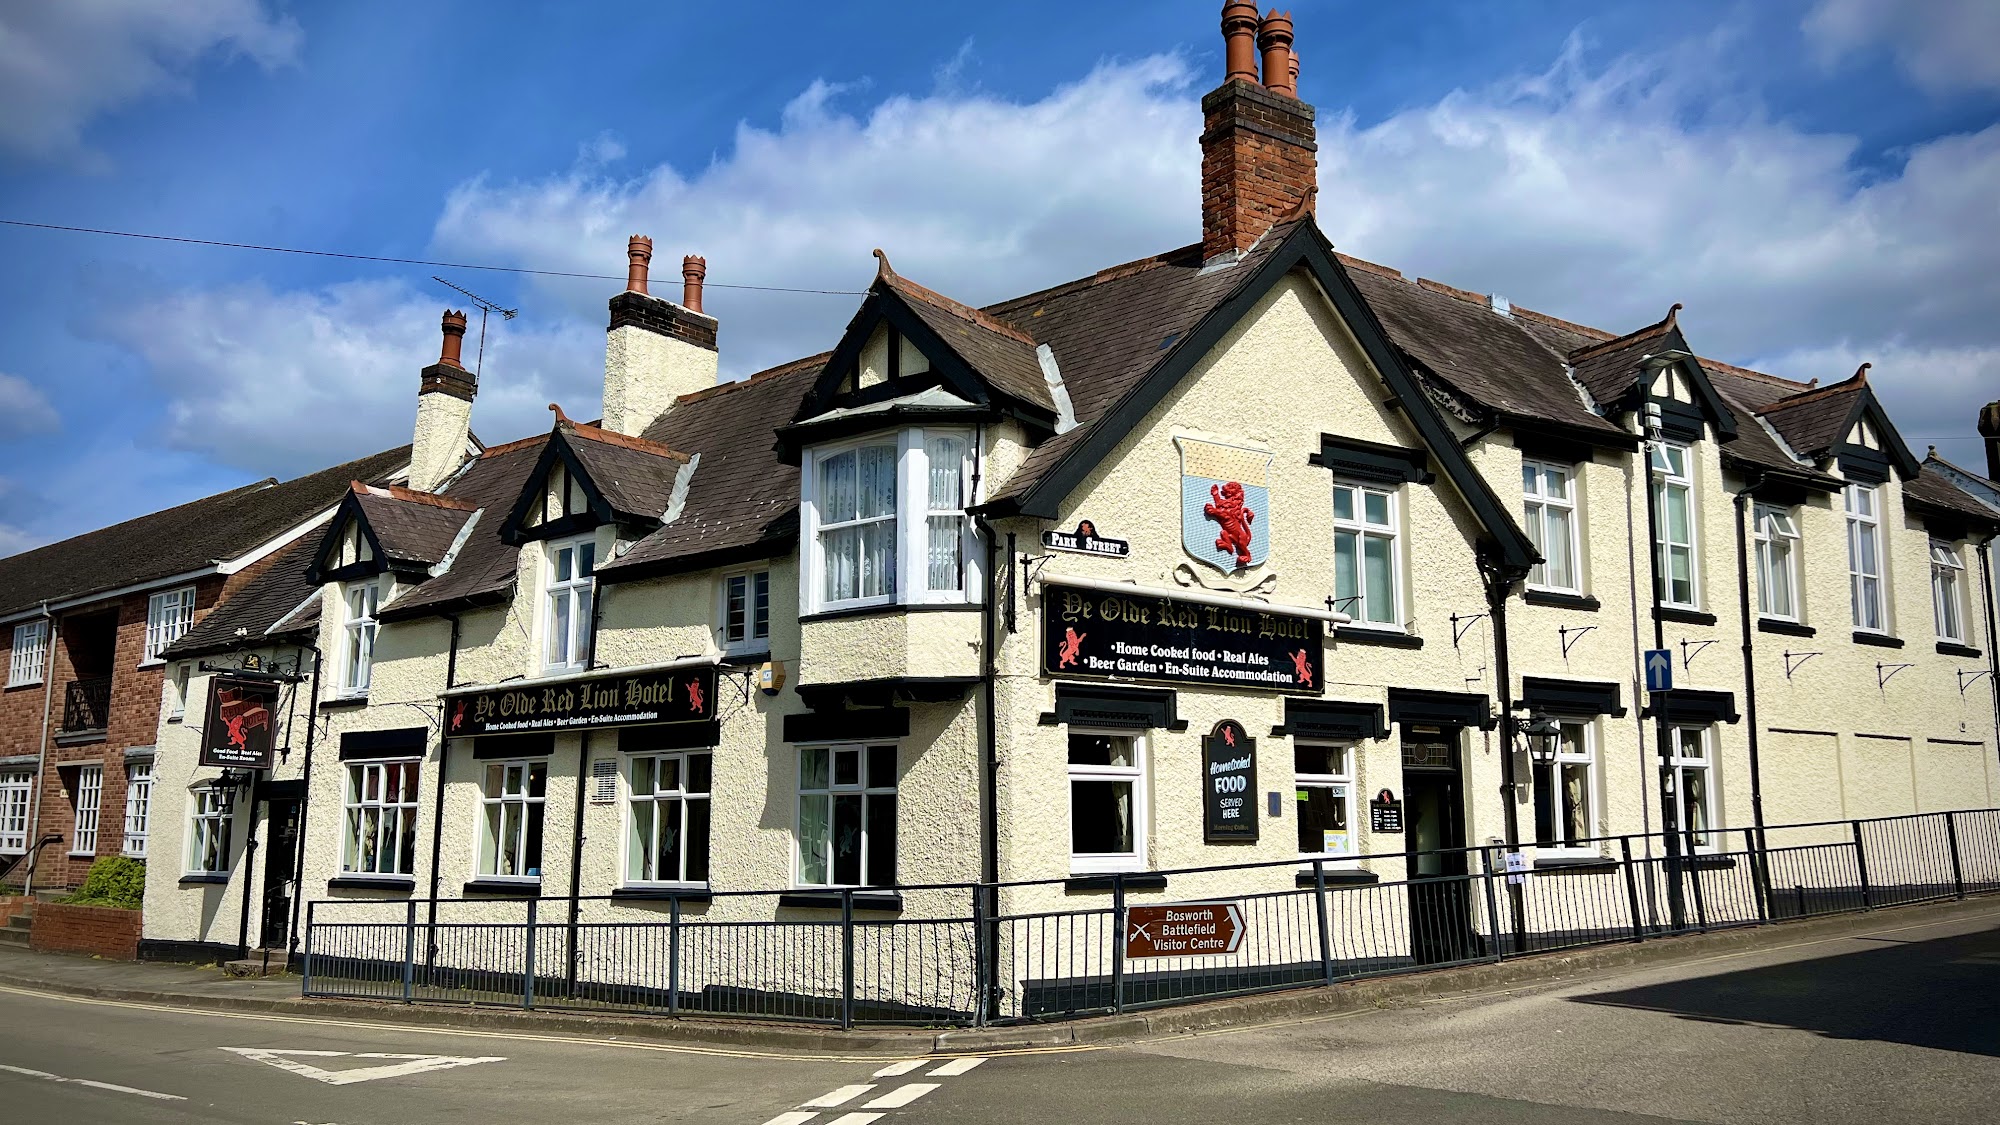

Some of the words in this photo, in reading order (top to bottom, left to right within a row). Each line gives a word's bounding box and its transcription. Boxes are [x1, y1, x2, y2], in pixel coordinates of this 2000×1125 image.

[1051, 532, 1077, 548] PARK
[1085, 537, 1121, 553] STREET
[1062, 591, 1092, 622] Ye
[1099, 596, 1151, 625] Olde
[1157, 600, 1198, 630] Red
[1204, 606, 1251, 634] Lion
[1258, 613, 1309, 640] Hotel
[1116, 642, 1148, 656] Home
[1150, 644, 1189, 660] Cooked
[1191, 647, 1216, 661] food
[1223, 651, 1246, 664] Real
[1248, 653, 1269, 665] Ales
[1089, 657, 1115, 670] Beer
[1117, 658, 1157, 673] Garden
[1165, 663, 1210, 677] En-Suite
[1211, 666, 1293, 684] Accommodation
[473, 695, 496, 723] Ye
[500, 691, 536, 716] Olde
[541, 687, 574, 713] Red
[579, 683, 619, 711] Lion
[624, 676, 674, 710] Hotel
[224, 707, 239, 717] RED
[243, 713, 265, 726] HOTEL
[485, 722, 499, 731] Home
[500, 721, 517, 730] Cooked
[517, 720, 529, 729] food
[532, 718, 543, 728] Real
[543, 718, 553, 727] Ales
[557, 717, 569, 726] Beer
[569, 716, 587, 726] Garden
[591, 714, 613, 724] En-Suite
[613, 711, 658, 722] Accommodation
[1214, 775, 1247, 794] FOOD
[1219, 797, 1243, 809] SERVED
[1222, 808, 1241, 819] HERE
[1166, 909, 1213, 922] Bosworth
[1162, 923, 1216, 936] Battlefield
[1153, 938, 1187, 951] Visitor
[1190, 937, 1224, 949] Centre
